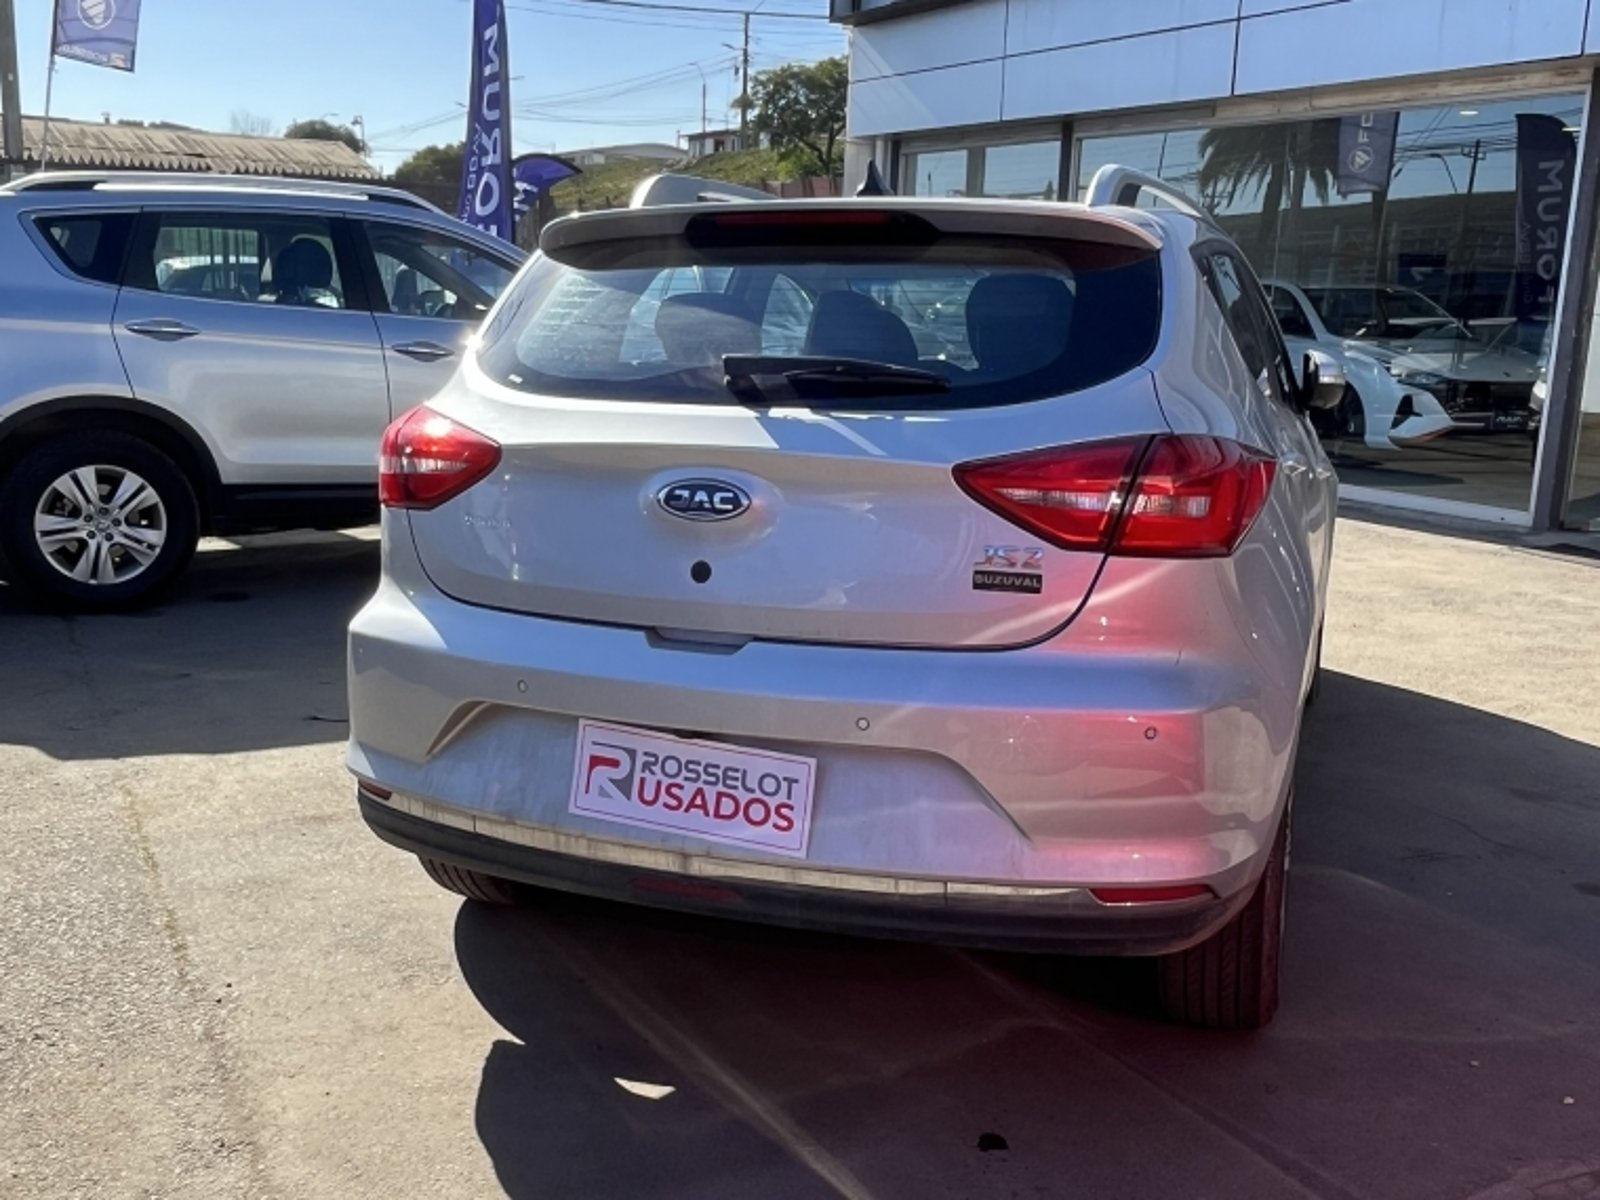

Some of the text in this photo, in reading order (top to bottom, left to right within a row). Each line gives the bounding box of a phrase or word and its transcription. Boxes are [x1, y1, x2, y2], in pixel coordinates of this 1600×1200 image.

[669, 489, 734, 511] JAC
[640, 751, 799, 800] ROSSELOT
[637, 777, 795, 832] USADOS
